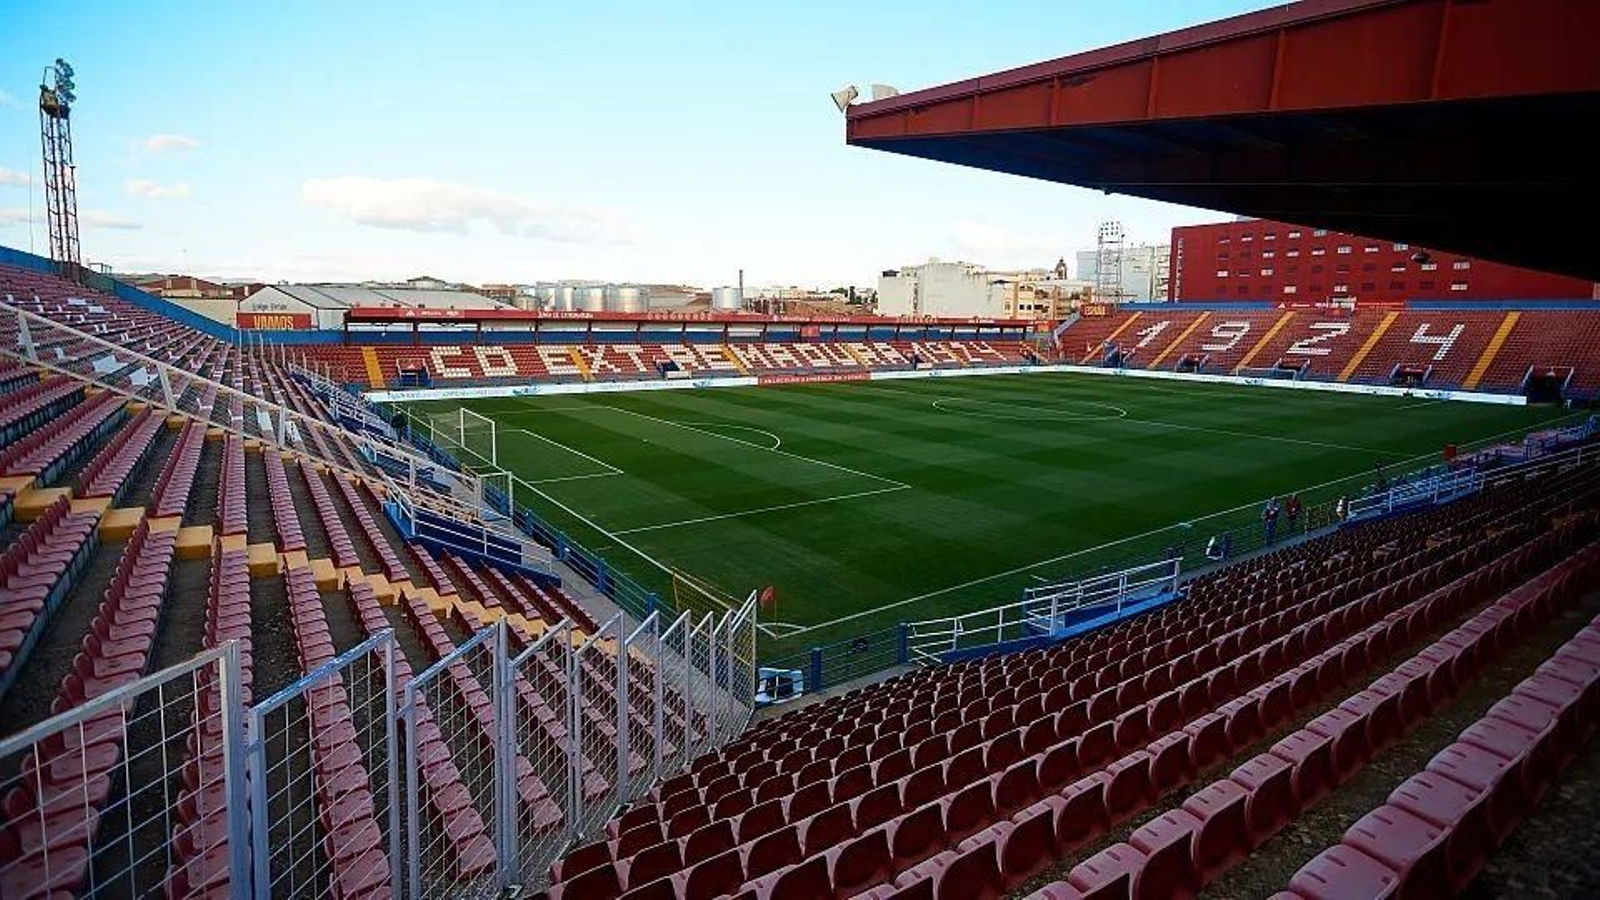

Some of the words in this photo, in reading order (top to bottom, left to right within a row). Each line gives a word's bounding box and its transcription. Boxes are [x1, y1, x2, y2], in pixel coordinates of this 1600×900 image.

[253, 315, 294, 330] VAMOS
[1134, 320, 1466, 361] 1924
[429, 345, 519, 378] CD
